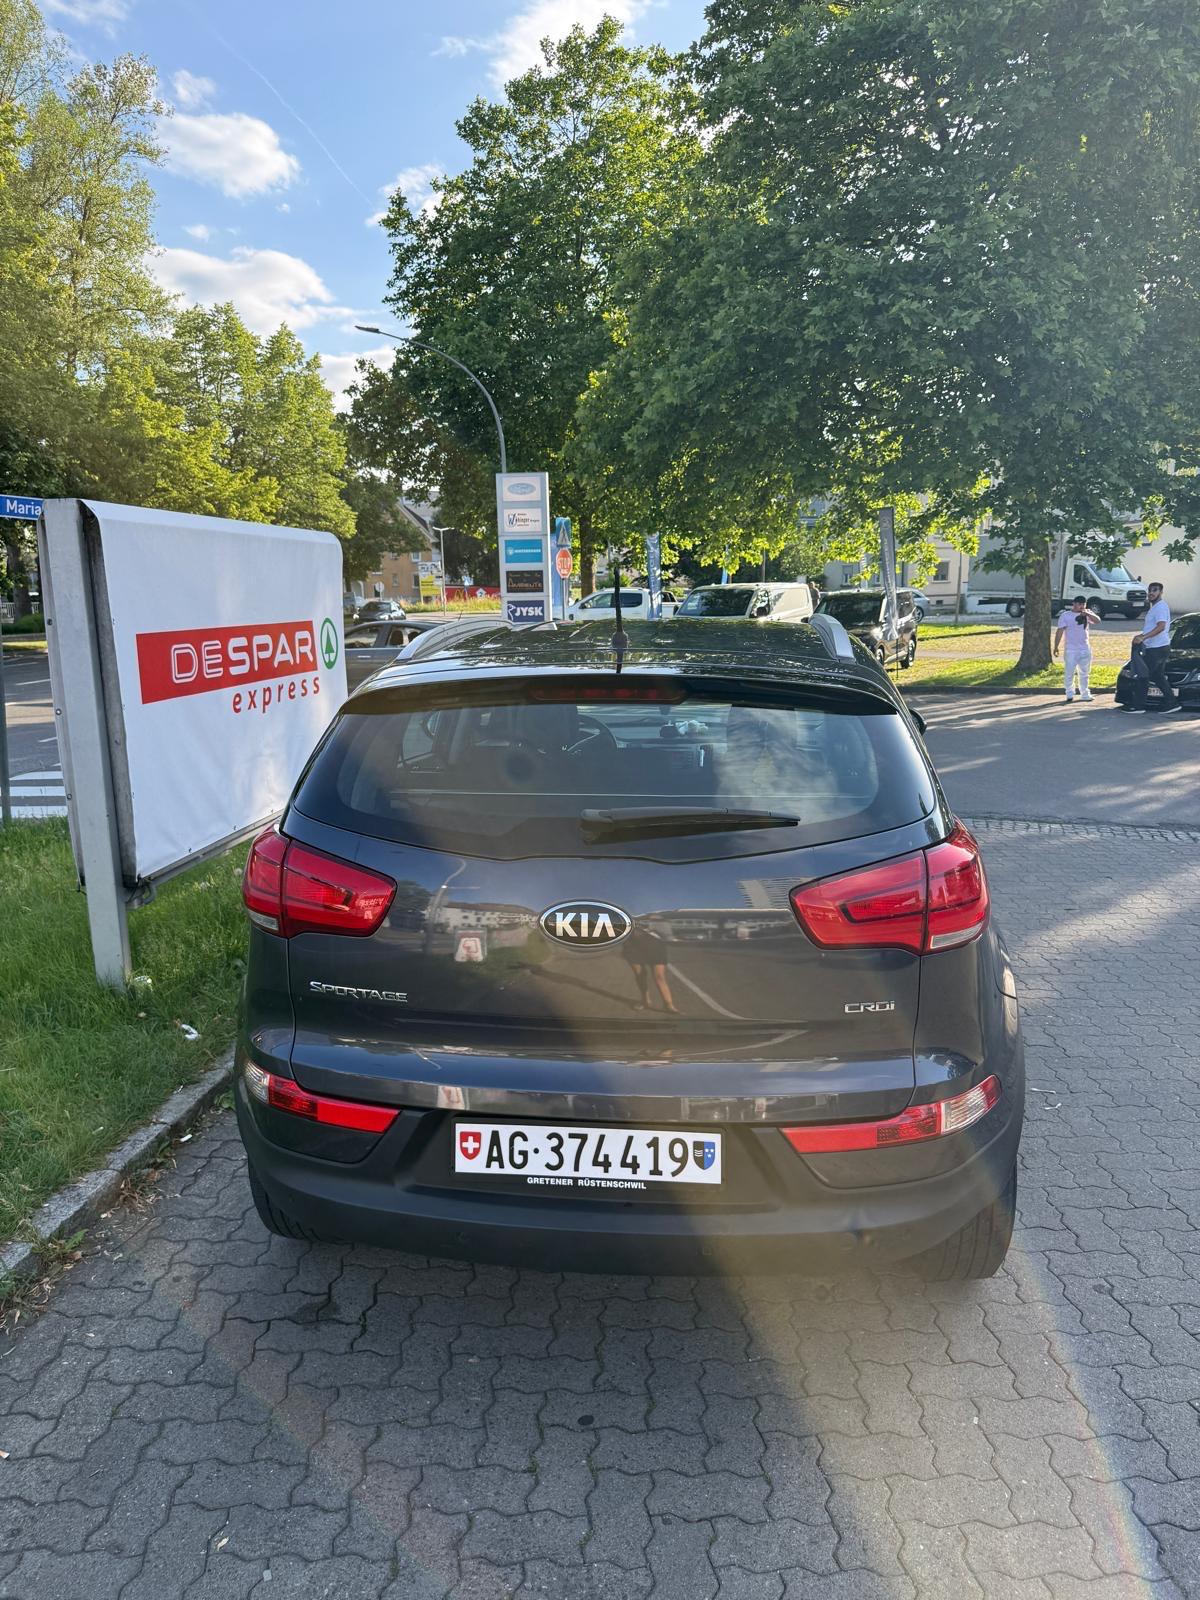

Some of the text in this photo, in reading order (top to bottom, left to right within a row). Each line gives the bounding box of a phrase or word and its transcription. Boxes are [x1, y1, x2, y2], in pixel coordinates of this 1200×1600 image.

[515, 606, 543, 616] JYSK
[170, 630, 314, 684] DESPAR
[232, 676, 320, 714] express
[555, 912, 616, 938] KIA
[309, 981, 408, 1003] SPORTAGE
[844, 1000, 895, 1013] CRDi
[527, 1176, 647, 1190] GRETENER RÜSTENSCHWIL
